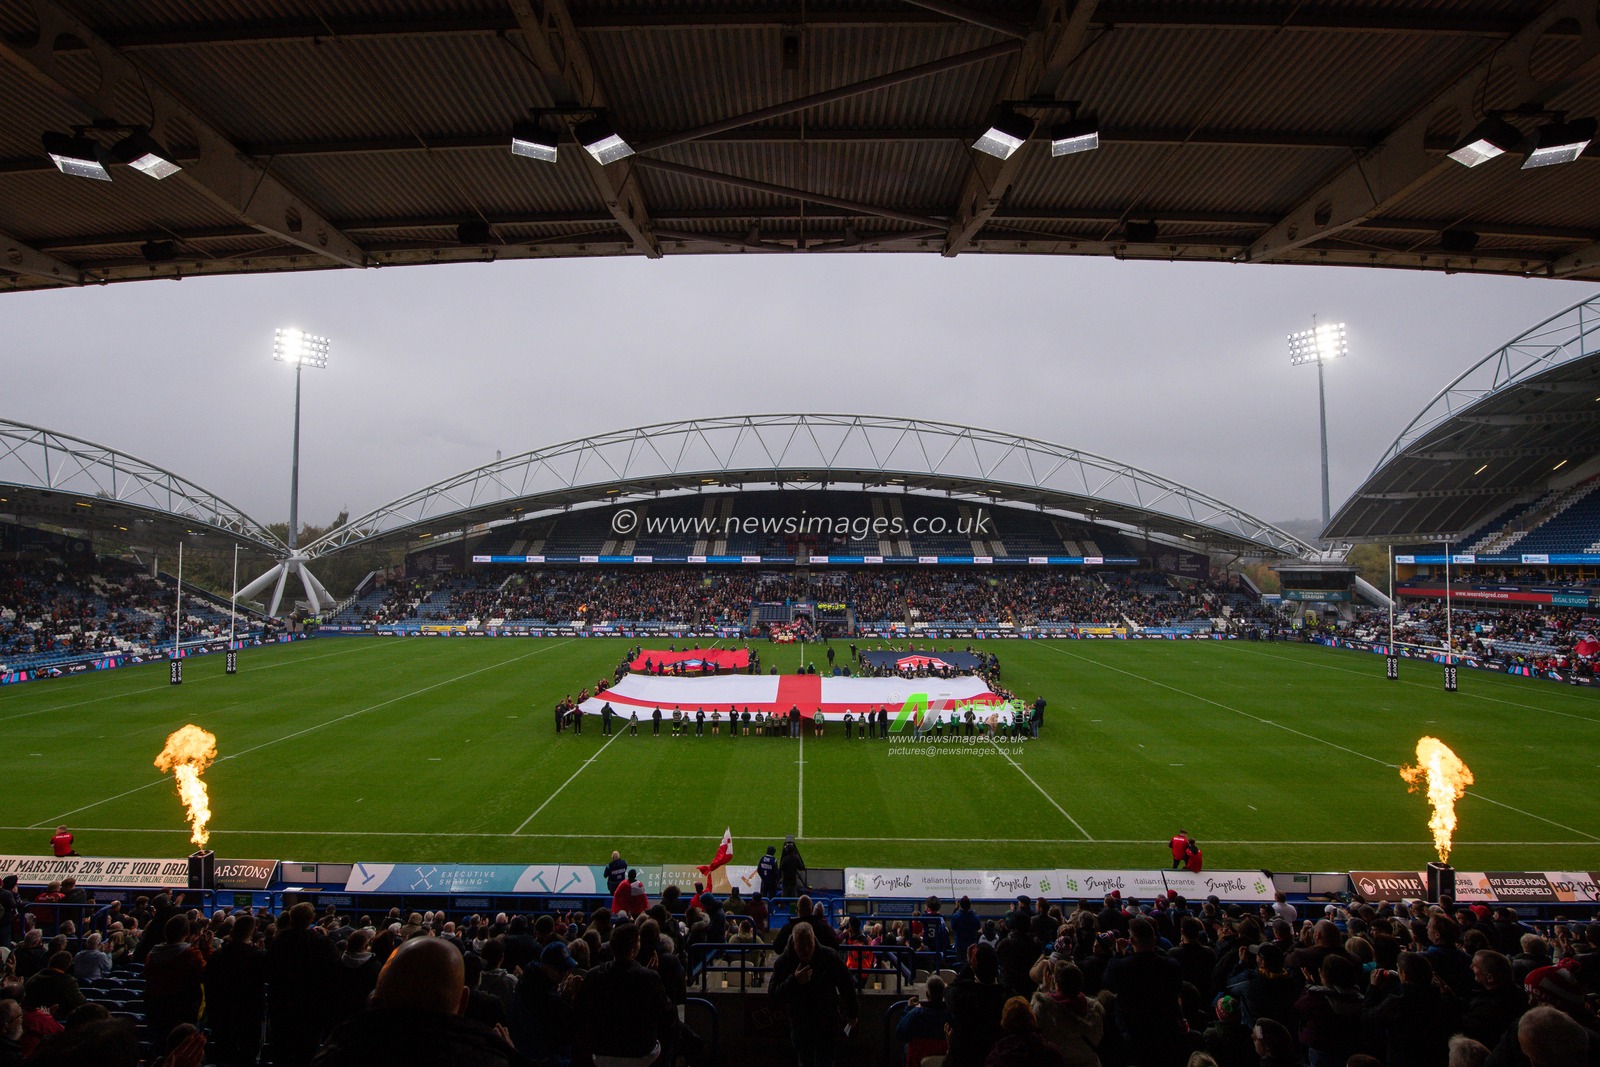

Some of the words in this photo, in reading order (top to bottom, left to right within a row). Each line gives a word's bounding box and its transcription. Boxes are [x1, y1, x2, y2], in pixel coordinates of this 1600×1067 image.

[0, 860, 16, 872] AY
[14, 860, 79, 873] MARSTONS
[79, 861, 104, 874] 20%
[105, 862, 130, 875] OFF
[130, 862, 161, 875] YOUR
[647, 879, 691, 887] SHAVING
[872, 875, 914, 893] Grappolo
[921, 877, 945, 885] italian
[991, 875, 1033, 893] Grappolo
[1083, 875, 1126, 892] Grappolo
[1133, 877, 1158, 885] italian
[1204, 877, 1248, 893] Grappolo
[1375, 878, 1422, 890] HOME
[1501, 878, 1526, 886] LEEDS
[1525, 878, 1547, 886] ROAD
[1551, 881, 1578, 893] HD2
[1494, 887, 1552, 895] HUDDERSFIELD
